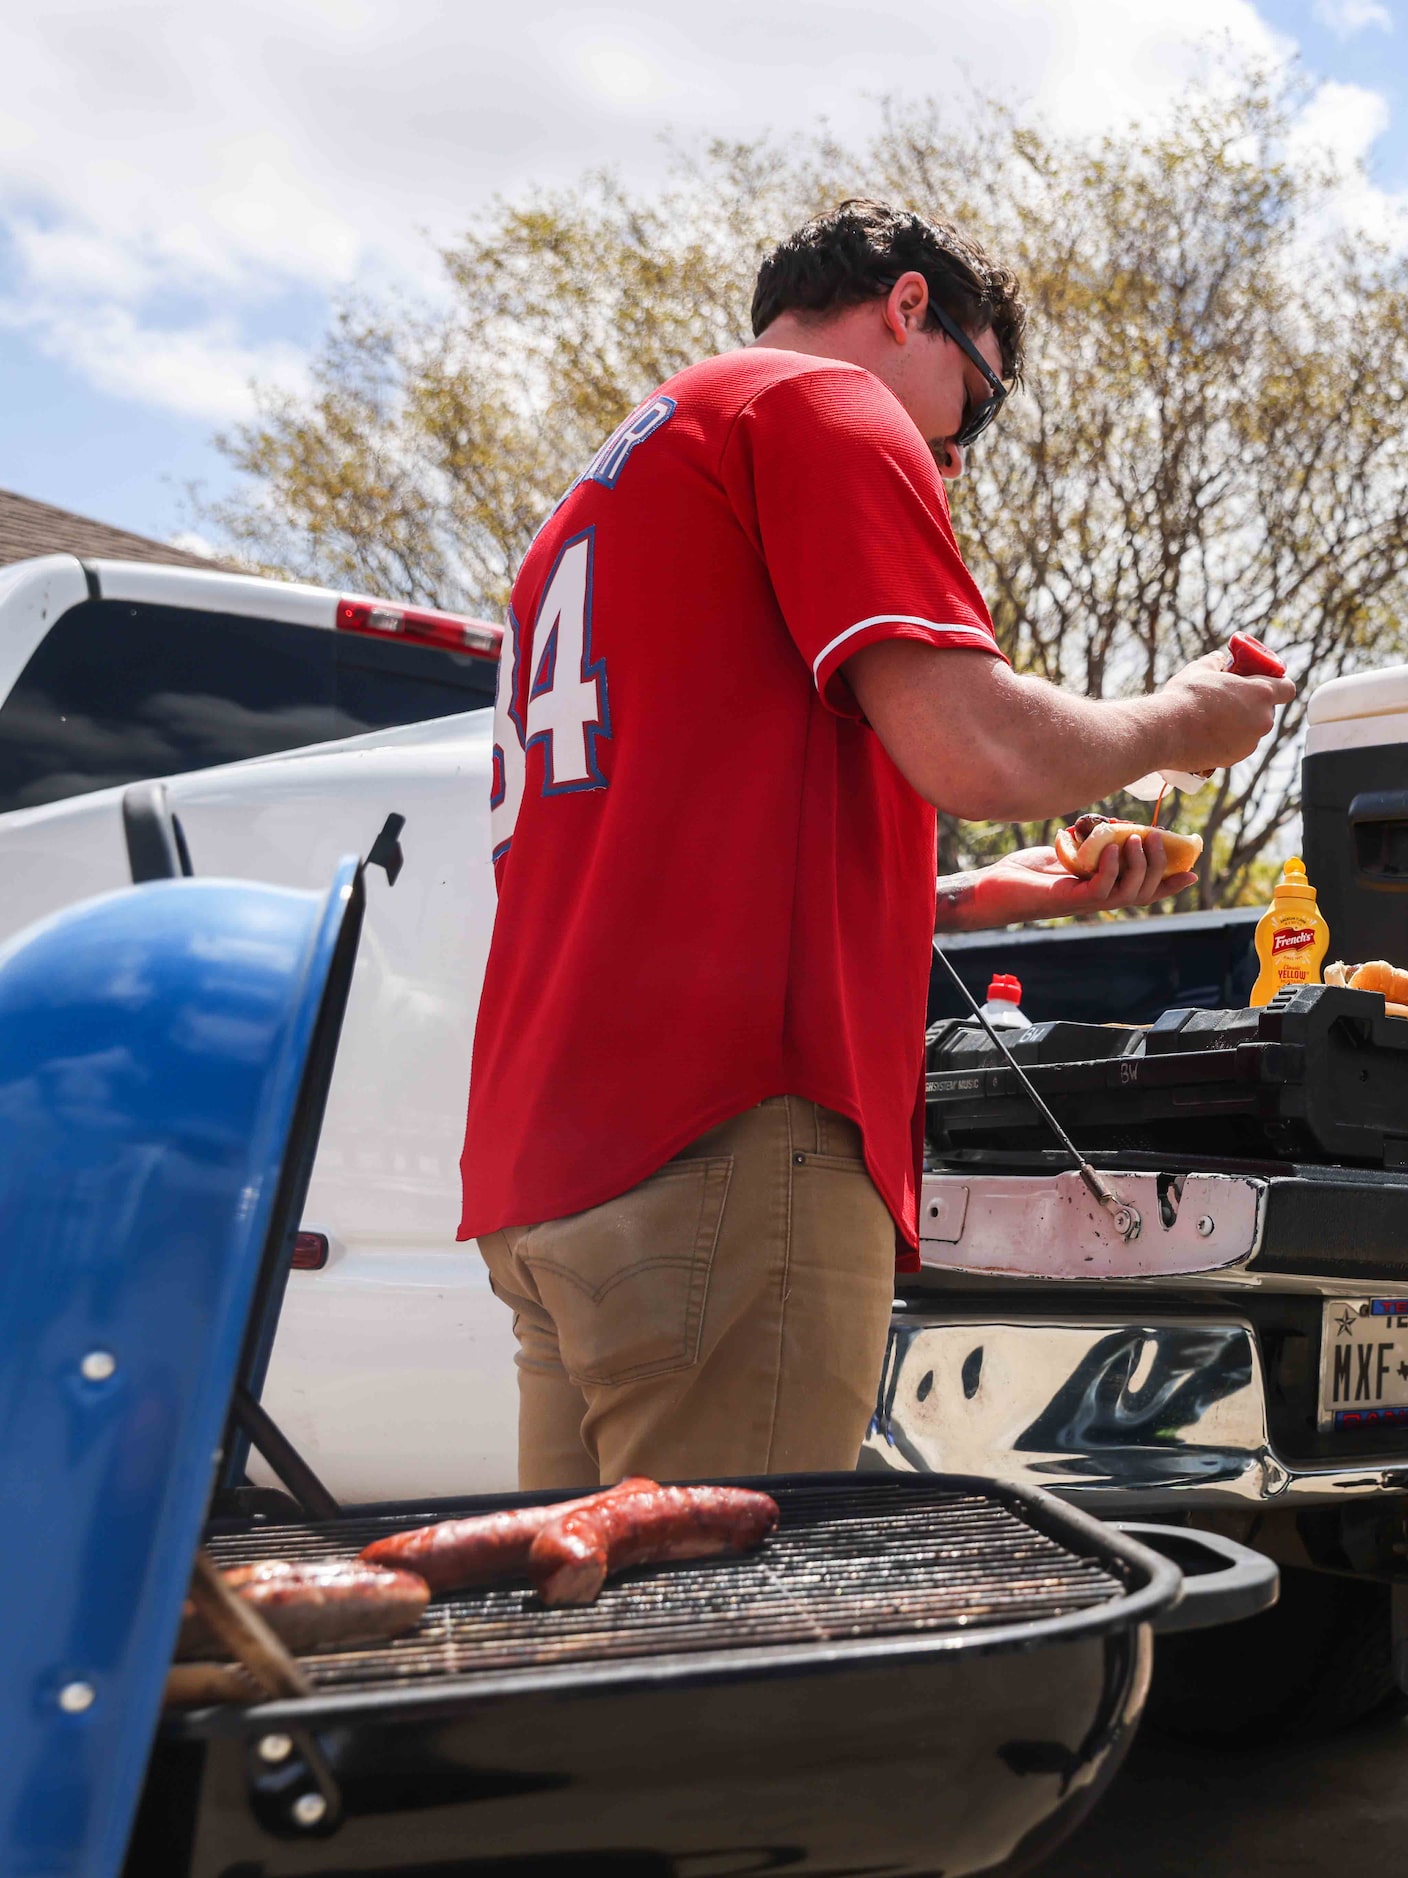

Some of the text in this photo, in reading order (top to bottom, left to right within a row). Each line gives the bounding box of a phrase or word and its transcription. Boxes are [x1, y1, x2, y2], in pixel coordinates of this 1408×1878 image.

[1274, 932, 1311, 949] French's
[1278, 970, 1306, 980] YELLOW
[1333, 1343, 1394, 1402] MXF
